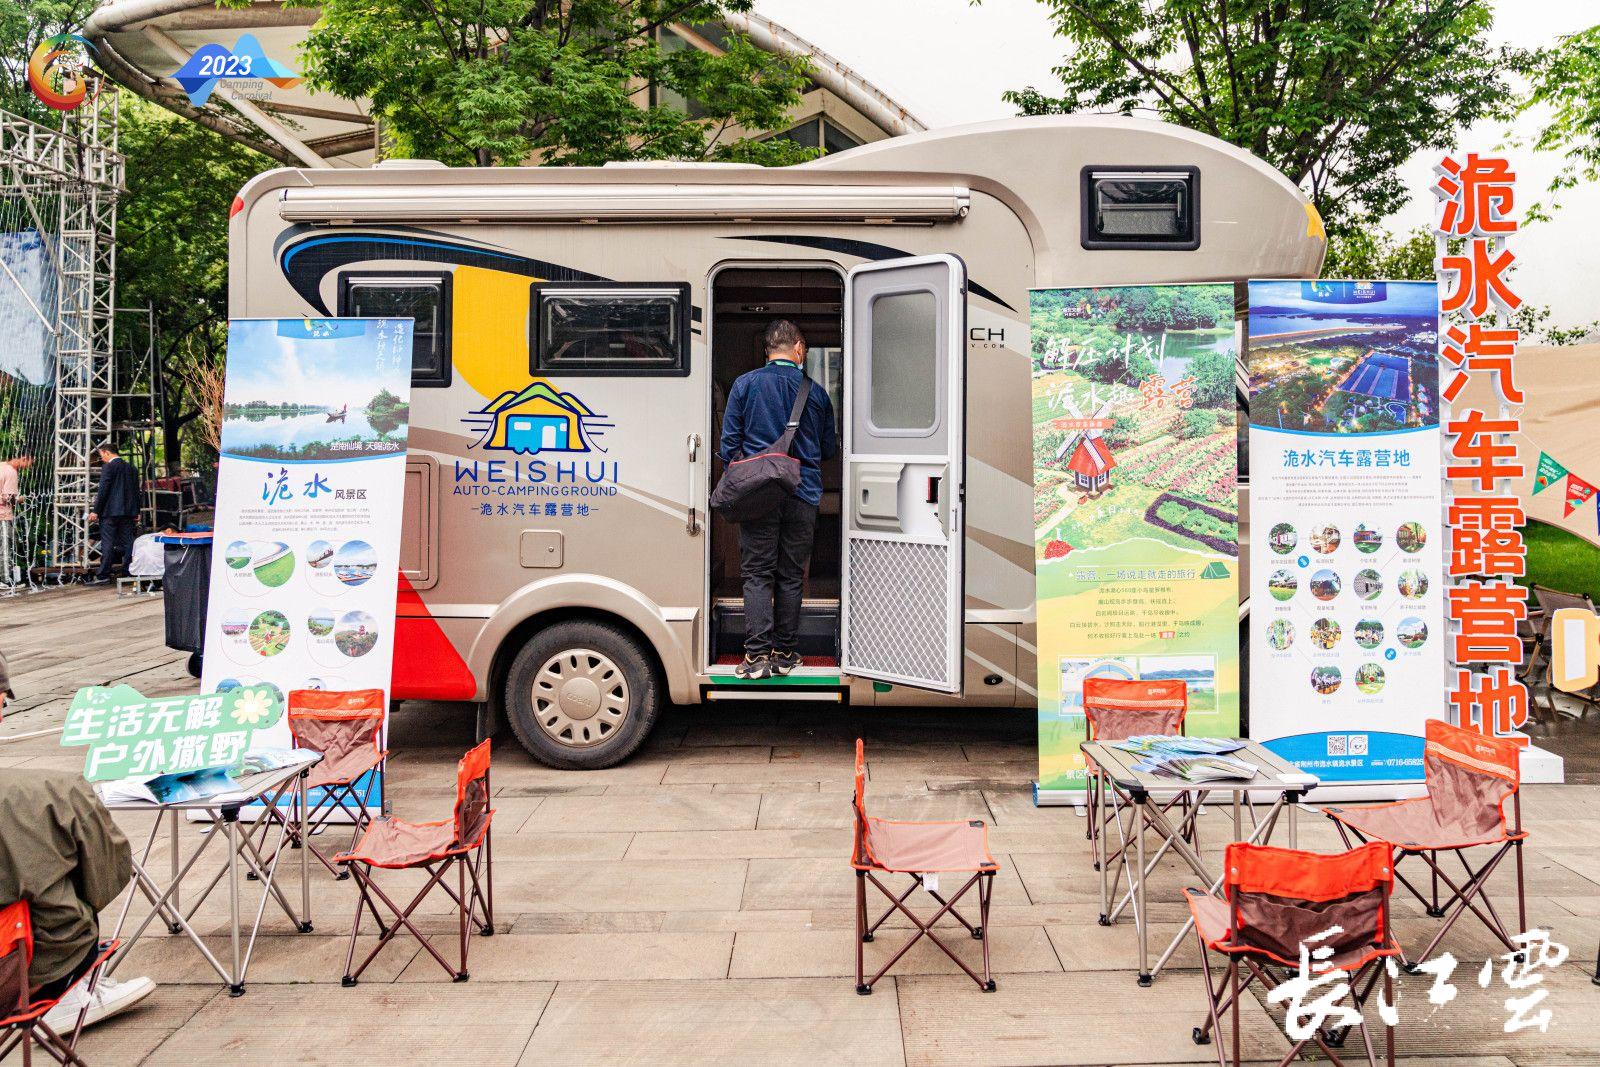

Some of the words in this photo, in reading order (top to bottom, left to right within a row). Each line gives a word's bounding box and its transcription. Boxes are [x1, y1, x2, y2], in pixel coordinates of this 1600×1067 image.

[1283, 449, 1411, 468] 洈水汽车露营地
[1430, 152, 1528, 749] 洈水汽车露营地
[455, 460, 619, 484] WEISHUI
[334, 488, 368, 501] 风景区
[65, 697, 224, 743] 生活无解
[87, 730, 248, 779] 户外撒野
